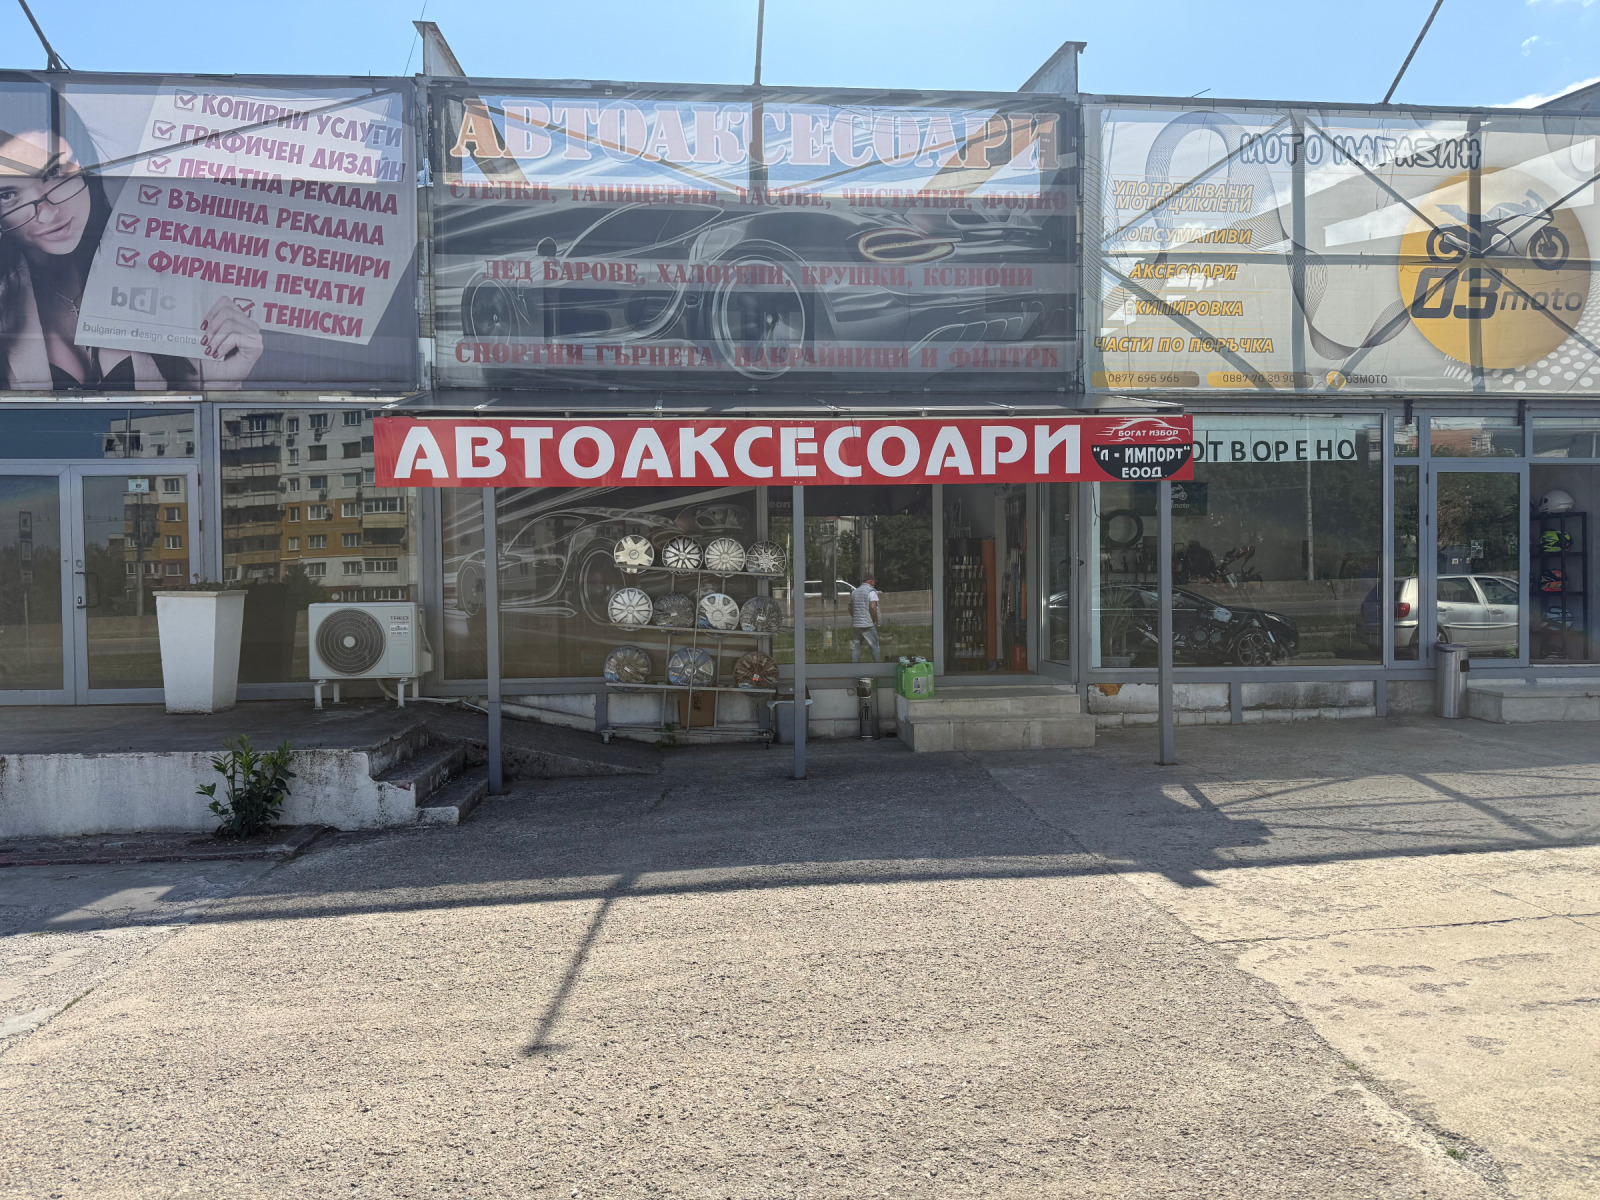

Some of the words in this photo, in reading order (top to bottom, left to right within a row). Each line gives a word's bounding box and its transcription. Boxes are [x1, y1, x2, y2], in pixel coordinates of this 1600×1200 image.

[201, 92, 307, 131] КОПИРНИ
[315, 114, 402, 149] УСЛУГИ
[450, 98, 1060, 170] АВТОАКСЕСОАРИ
[180, 124, 303, 165] ГРАФИЧЕН
[310, 147, 406, 183] ДИЗАЙН
[1240, 132, 1323, 166] МОТО
[1332, 134, 1481, 170] МАГАЗИН
[178, 158, 284, 195] ПЕЧАТНА
[290, 178, 398, 215] РЕКЛАМА
[450, 179, 557, 204] СТЕЛКИ,
[842, 187, 972, 211] ЧИСТАЧКИ,
[983, 189, 1067, 210] ФОЛИО
[1113, 181, 1254, 199] УПОТРЕБЯВАНИ
[168, 188, 269, 226] ВЪНШНА
[276, 211, 384, 246] РЕКЛАМА
[1115, 195, 1252, 214] МОТОЦИКЛЕТИ
[145, 217, 269, 259] РЕКЛАМНИ
[275, 241, 391, 280] СУВЕНИРИ
[1116, 227, 1253, 244] КОНСУМАТИВИ
[147, 250, 268, 290] ФИРМЕНИ
[275, 272, 365, 307] ПЕЧАТИ
[482, 259, 533, 283] ЛЕД
[543, 260, 646, 285] БАРОВЕ,
[657, 264, 791, 287] ХАЛОГЕНИ,
[802, 266, 913, 288] КРУШКИ,
[923, 267, 1033, 287] КСЕНОНИ
[1129, 263, 1238, 280] АКСЕСОАРИ
[263, 301, 363, 338] ТЕНИСКИ
[1125, 300, 1243, 317] ЕКИПИРОВКА
[83, 322, 127, 336] bulgarian
[131, 328, 163, 342] design
[167, 334, 197, 345] centre
[1094, 336, 1153, 352] ЧАСТИ
[1158, 337, 1184, 352] ПО
[1188, 337, 1274, 353] ПОРЪЧКА
[455, 341, 584, 366] СПОРТНИ
[596, 344, 722, 369] ГЪРНЕТА,
[920, 347, 938, 368] И
[949, 347, 1058, 368] ФИЛТРИ
[1108, 373, 1135, 383] 0877
[1149, 429, 1179, 437] ИЗБОР
[394, 424, 1080, 480] АВТОАКСЕСОАРИ
[1122, 466, 1162, 478] ЕООД
